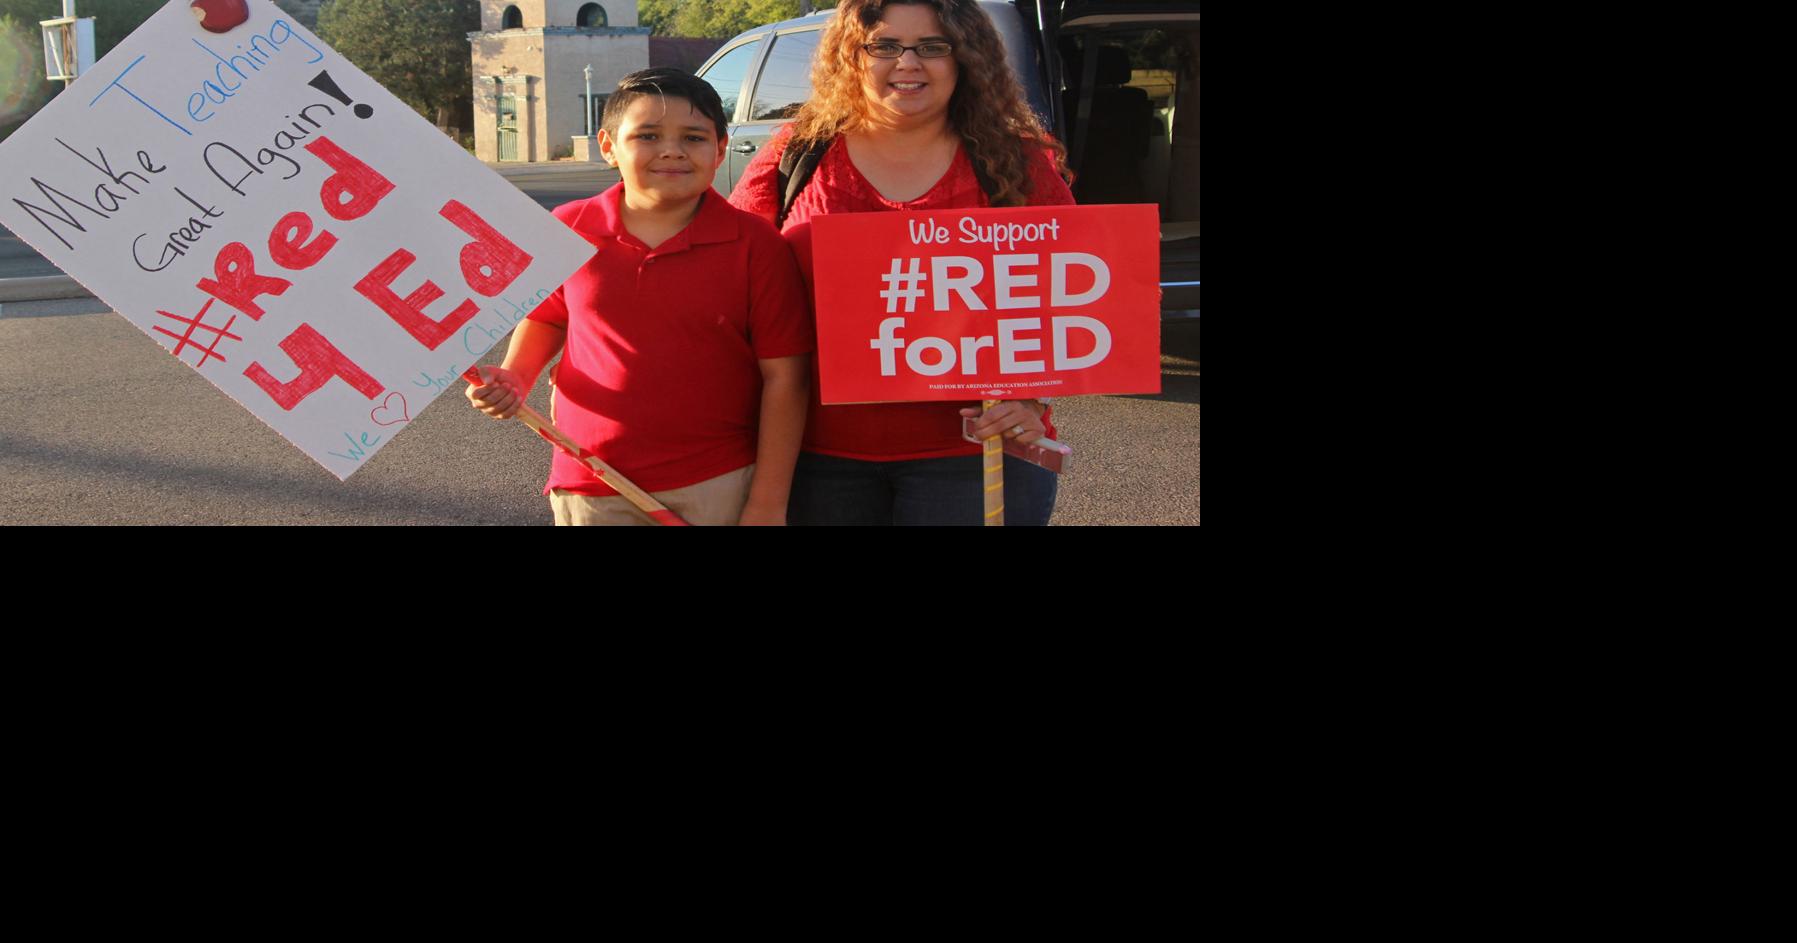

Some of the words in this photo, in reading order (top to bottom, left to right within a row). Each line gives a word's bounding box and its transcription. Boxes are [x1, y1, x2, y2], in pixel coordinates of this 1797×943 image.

[89, 19, 324, 136] Teaching
[132, 186, 225, 272] Great
[203, 69, 374, 196] Again!
[909, 218, 951, 245] We
[958, 216, 1060, 251] Support
[152, 135, 397, 367] #Red
[242, 322, 386, 411] 4
[353, 198, 534, 351] Ed
[879, 252, 1111, 313] #RED
[327, 431, 381, 461] We
[413, 364, 458, 397] Your
[463, 288, 550, 356] Children
[870, 315, 1112, 377] forED
